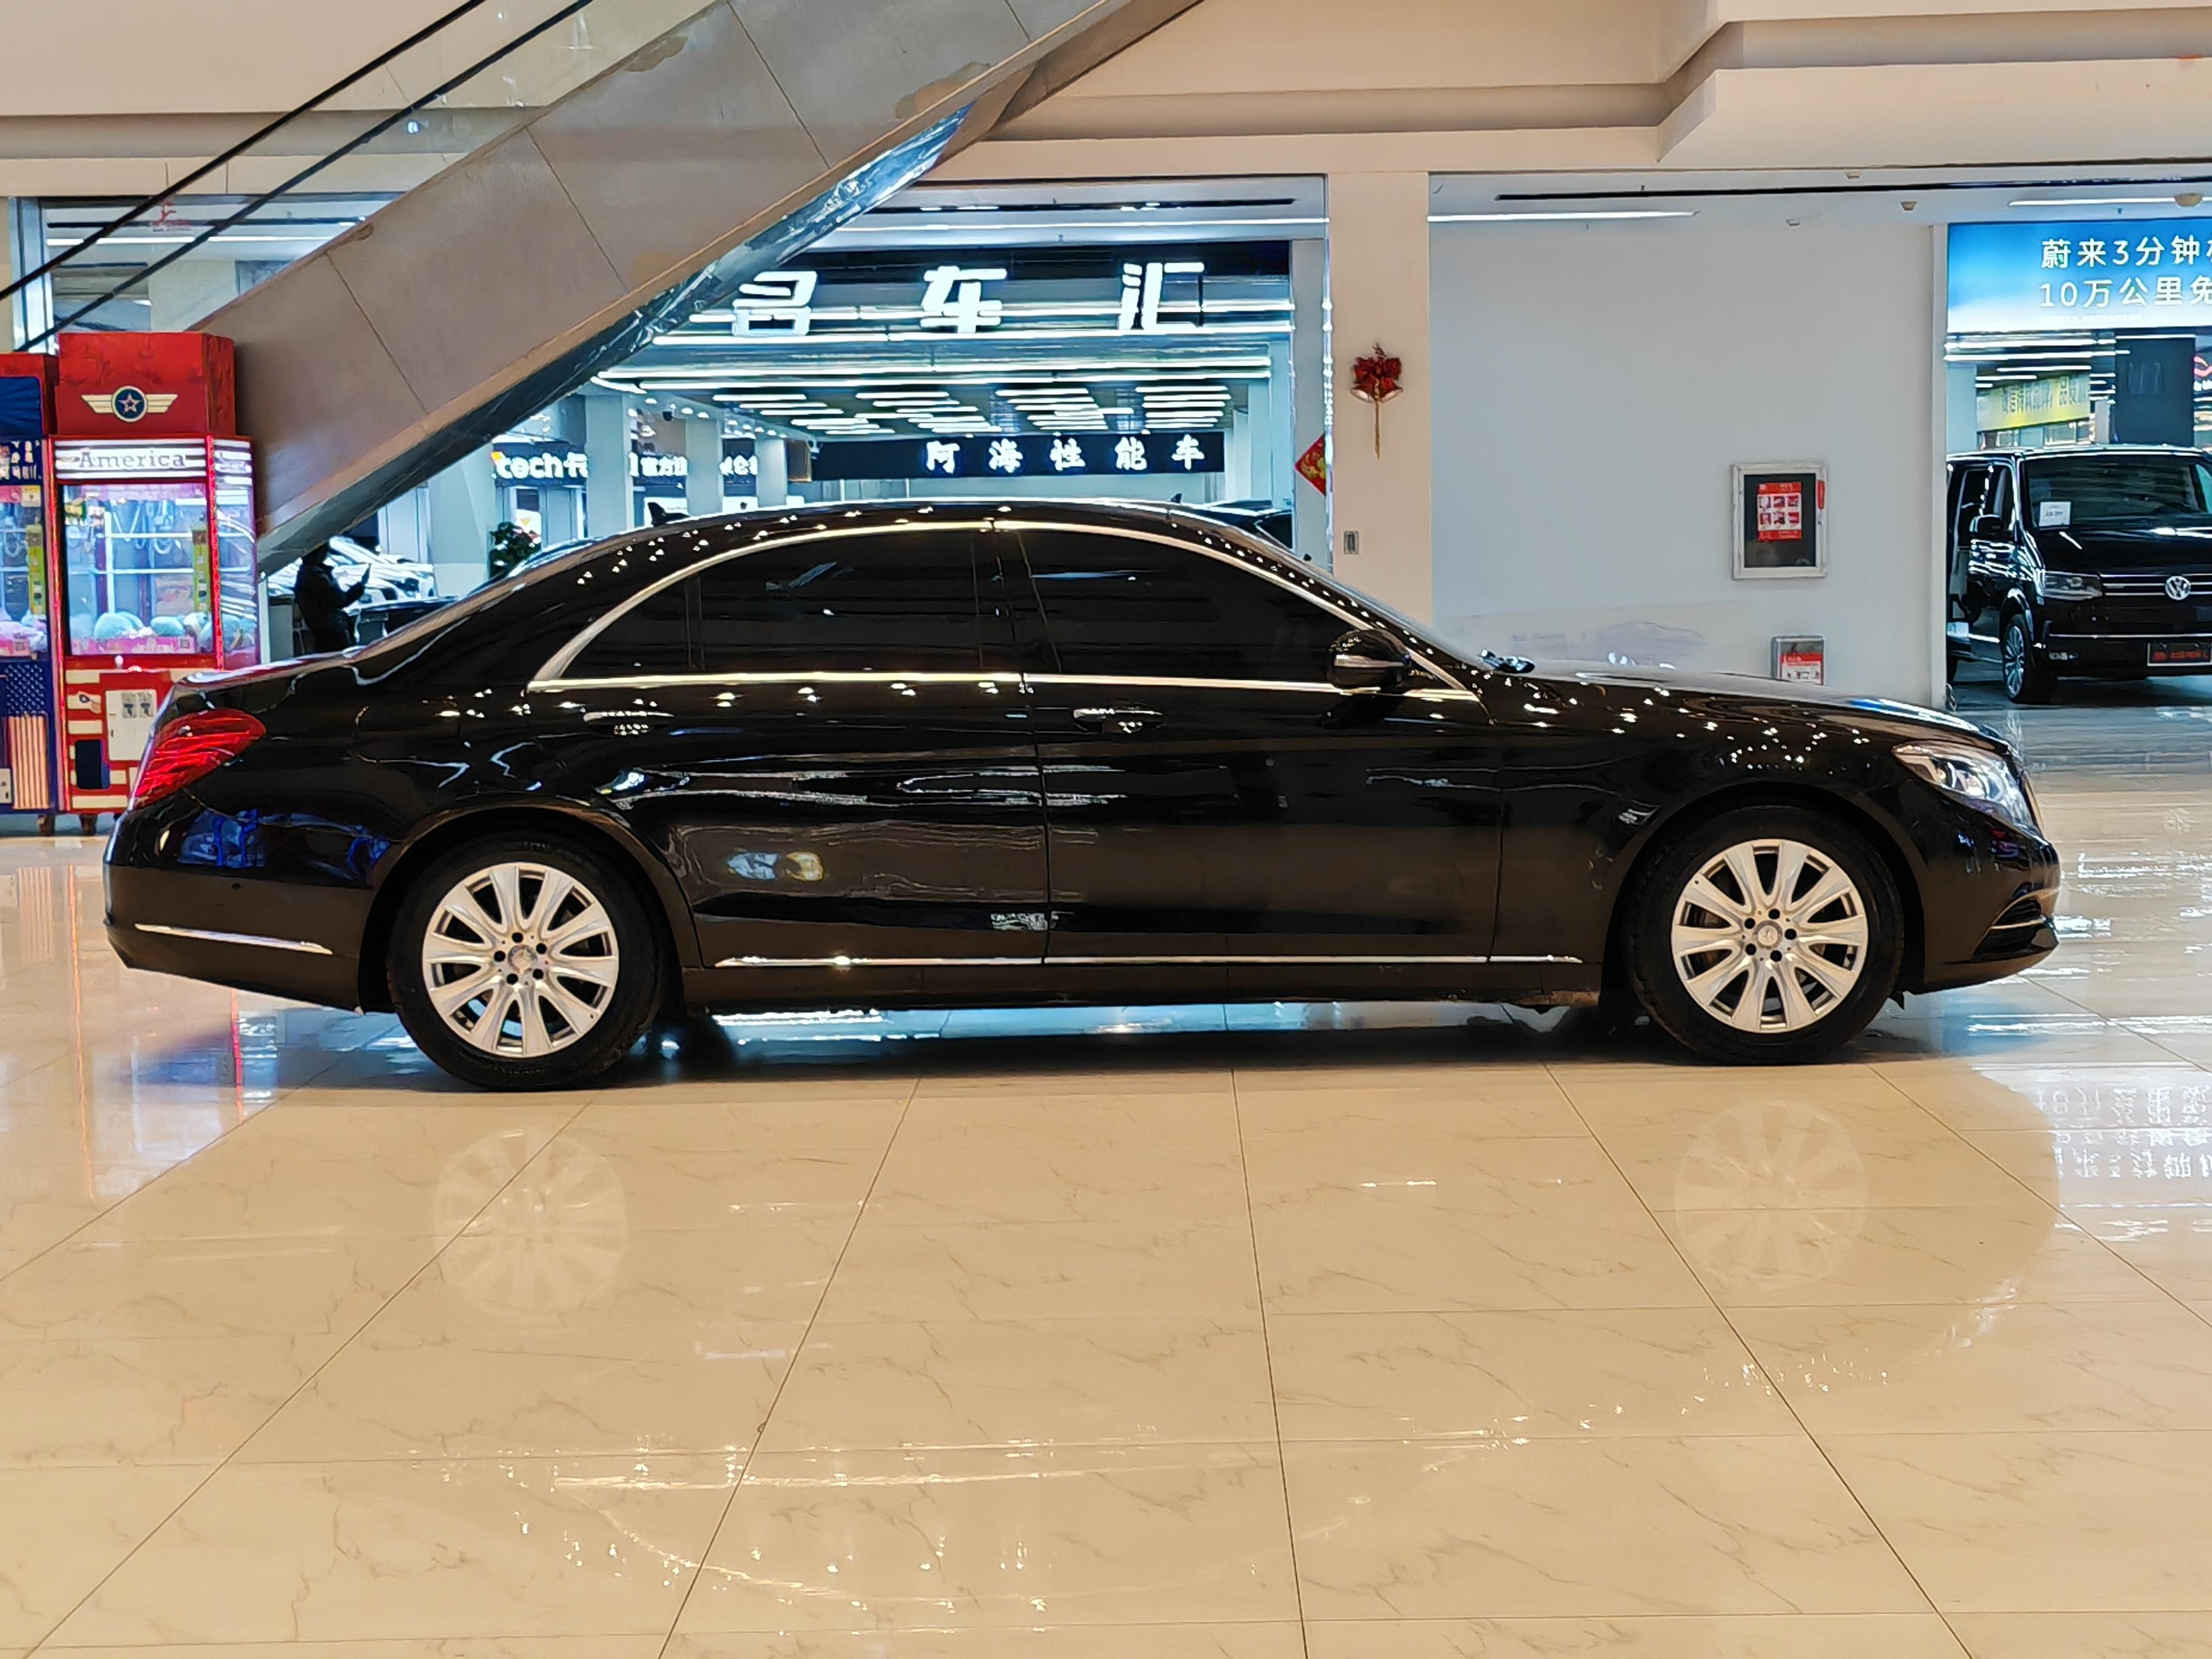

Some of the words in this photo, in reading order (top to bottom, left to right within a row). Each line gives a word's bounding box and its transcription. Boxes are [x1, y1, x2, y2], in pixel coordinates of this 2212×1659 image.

[2041, 234, 2212, 269] 蔚来3分钟
[2040, 275, 2212, 308] 10万公里免
[79, 450, 186, 468] America
